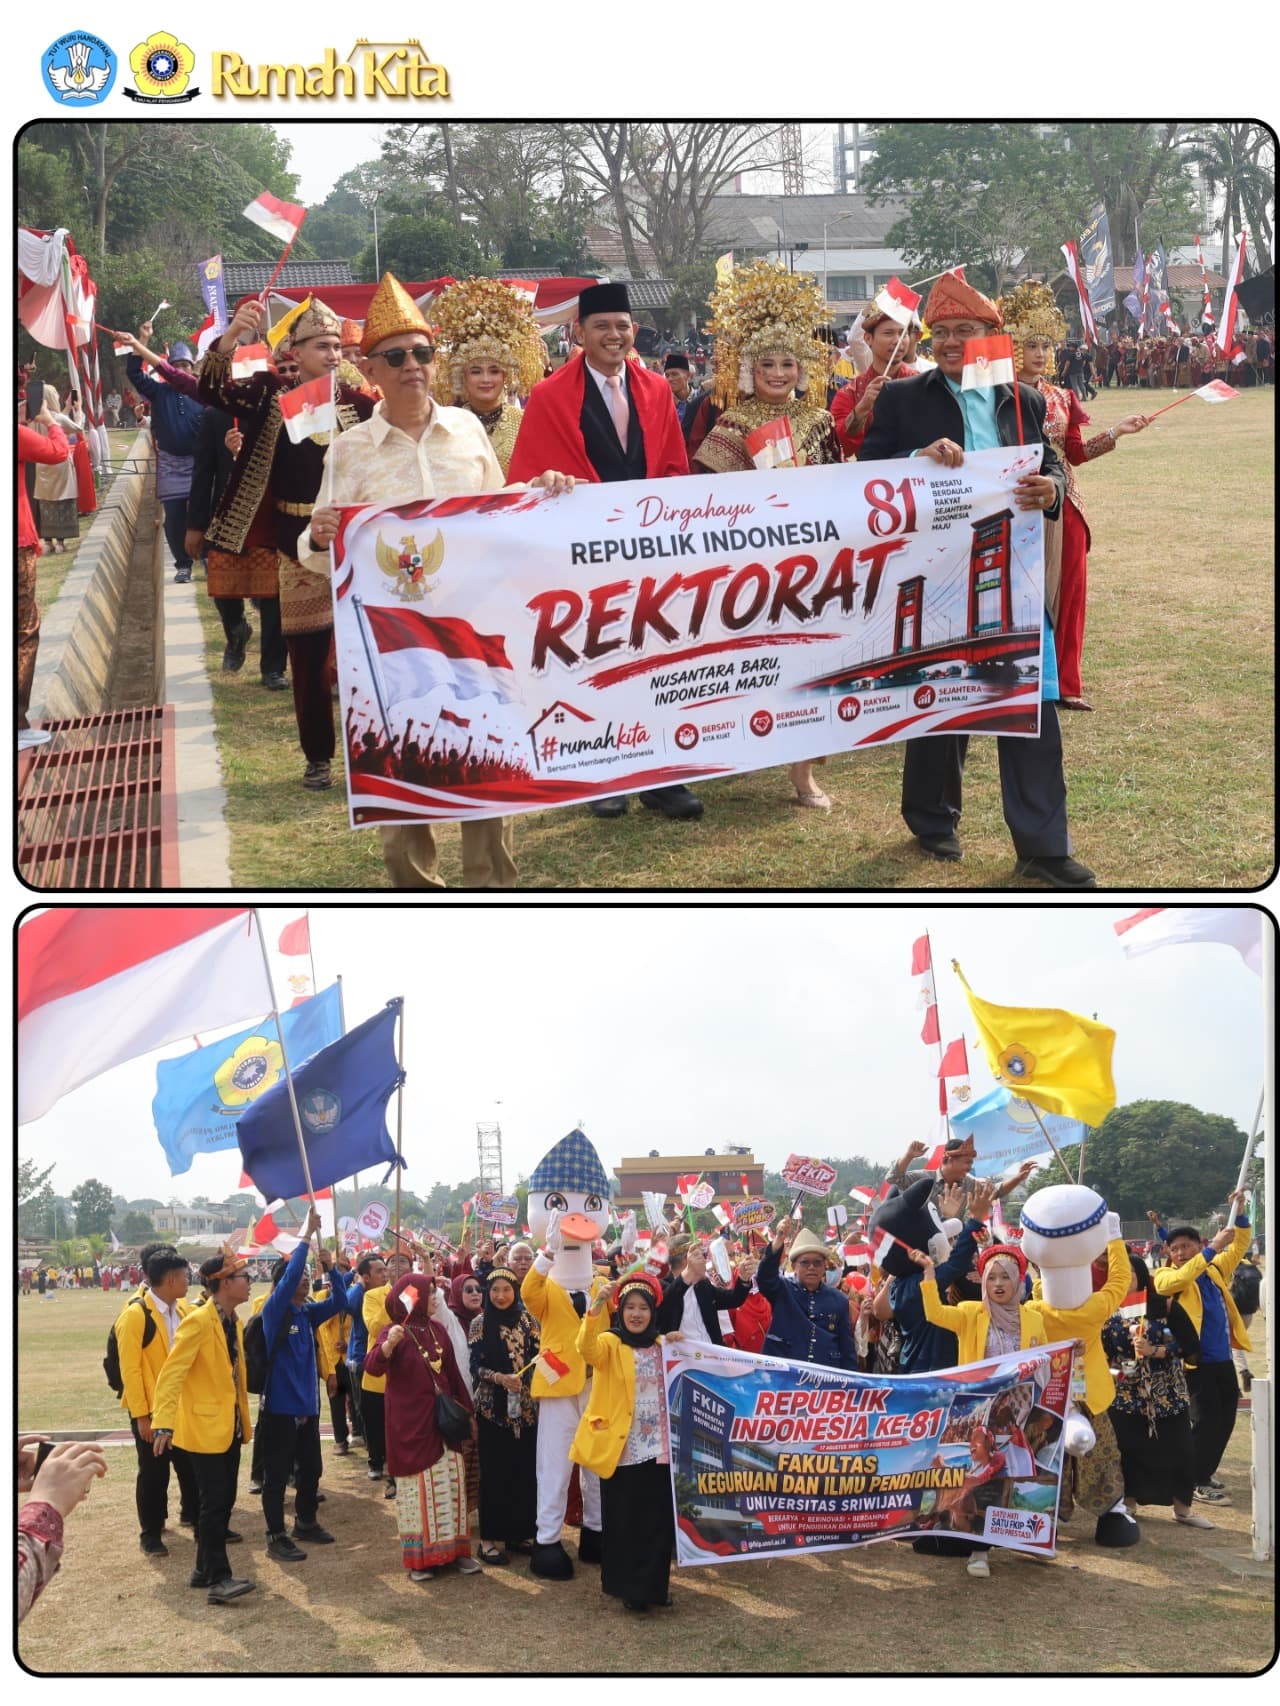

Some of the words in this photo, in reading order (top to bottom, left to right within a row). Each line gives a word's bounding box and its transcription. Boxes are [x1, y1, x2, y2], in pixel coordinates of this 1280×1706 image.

[930, 479, 962, 489] BERSATU
[932, 487, 973, 497] BERDAULAT
[934, 497, 961, 506] RAKYAT
[934, 504, 973, 515] SEJAHTERA
[637, 494, 756, 531] Dirgahayu
[933, 512, 969, 523] INDONESIA
[931, 523, 951, 531] MAJU
[571, 533, 697, 565] REPUBLIK
[705, 519, 840, 554] INDONESIA
[525, 538, 912, 673] REKTORAT
[650, 664, 734, 690] NUSANTARA
[741, 657, 781, 675] BARU,
[655, 680, 729, 706] INDONESIA
[735, 673, 780, 692] MAJU!
[938, 686, 982, 695] SEJAHTERA
[863, 696, 891, 707] RAKYAT
[776, 707, 819, 721] BERDAULAT
[702, 721, 735, 734] BERSATU
[547, 763, 576, 773] Bersama
[578, 755, 620, 768] Membangun
[621, 749, 654, 761] Indonesia
[798, 1164, 831, 1182] FKIP
[362, 1209, 383, 1230] 81
[693, 1389, 725, 1416] FKIP
[754, 1388, 892, 1417] REPUBLIK
[729, 1415, 867, 1443] INDONESIA
[875, 1408, 944, 1441] KE-81
[777, 1453, 878, 1474] FAKULTAS
[697, 1471, 778, 1495] KEGURUAN
[782, 1475, 819, 1495] DAN
[824, 1475, 866, 1496] ILMU
[869, 1468, 966, 1493] PENDIDIKAN
[746, 1496, 838, 1512] UNIVERSITAS
[841, 1494, 913, 1511] SRIWIJAYA
[992, 1510, 1007, 1518] SATU
[798, 1522, 837, 1530] PENDIDIKAN
[839, 1522, 852, 1530] DAN
[991, 1518, 1009, 1528] SATU
[1010, 1520, 1025, 1530] FKIP
[991, 1527, 1005, 1536] SATU
